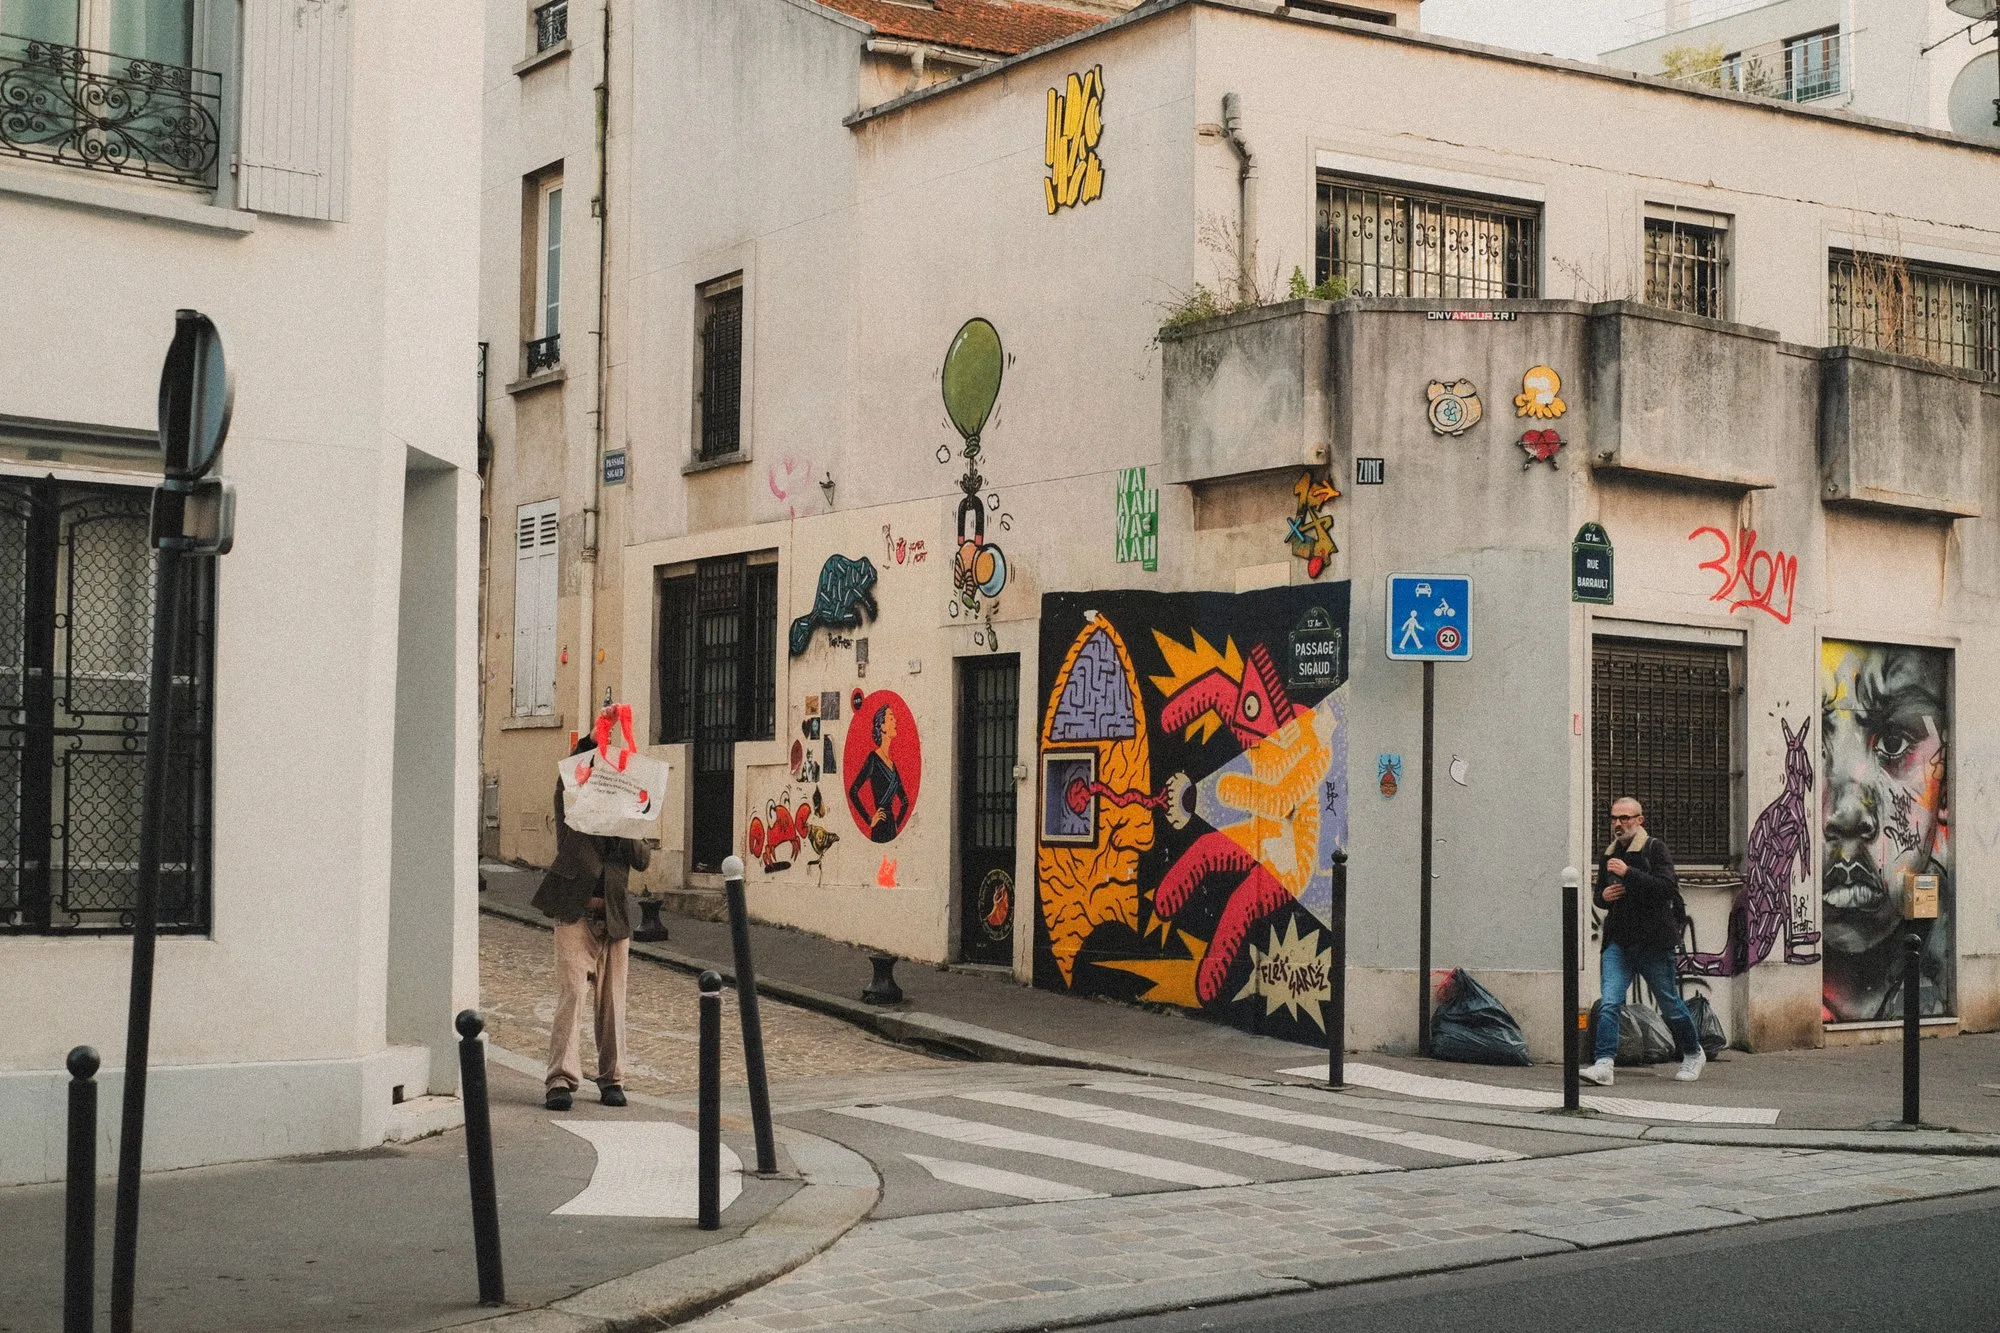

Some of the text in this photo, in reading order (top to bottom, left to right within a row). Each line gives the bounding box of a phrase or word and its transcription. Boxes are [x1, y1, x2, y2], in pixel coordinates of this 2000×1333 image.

[1358, 459, 1383, 483] ZINC
[1586, 558, 1600, 569] RUE
[1577, 576, 1609, 589] BARRAULT
[1442, 633, 1456, 643] 20
[1295, 641, 1335, 656] PASSAGE
[1299, 661, 1331, 676] SIGAUD
